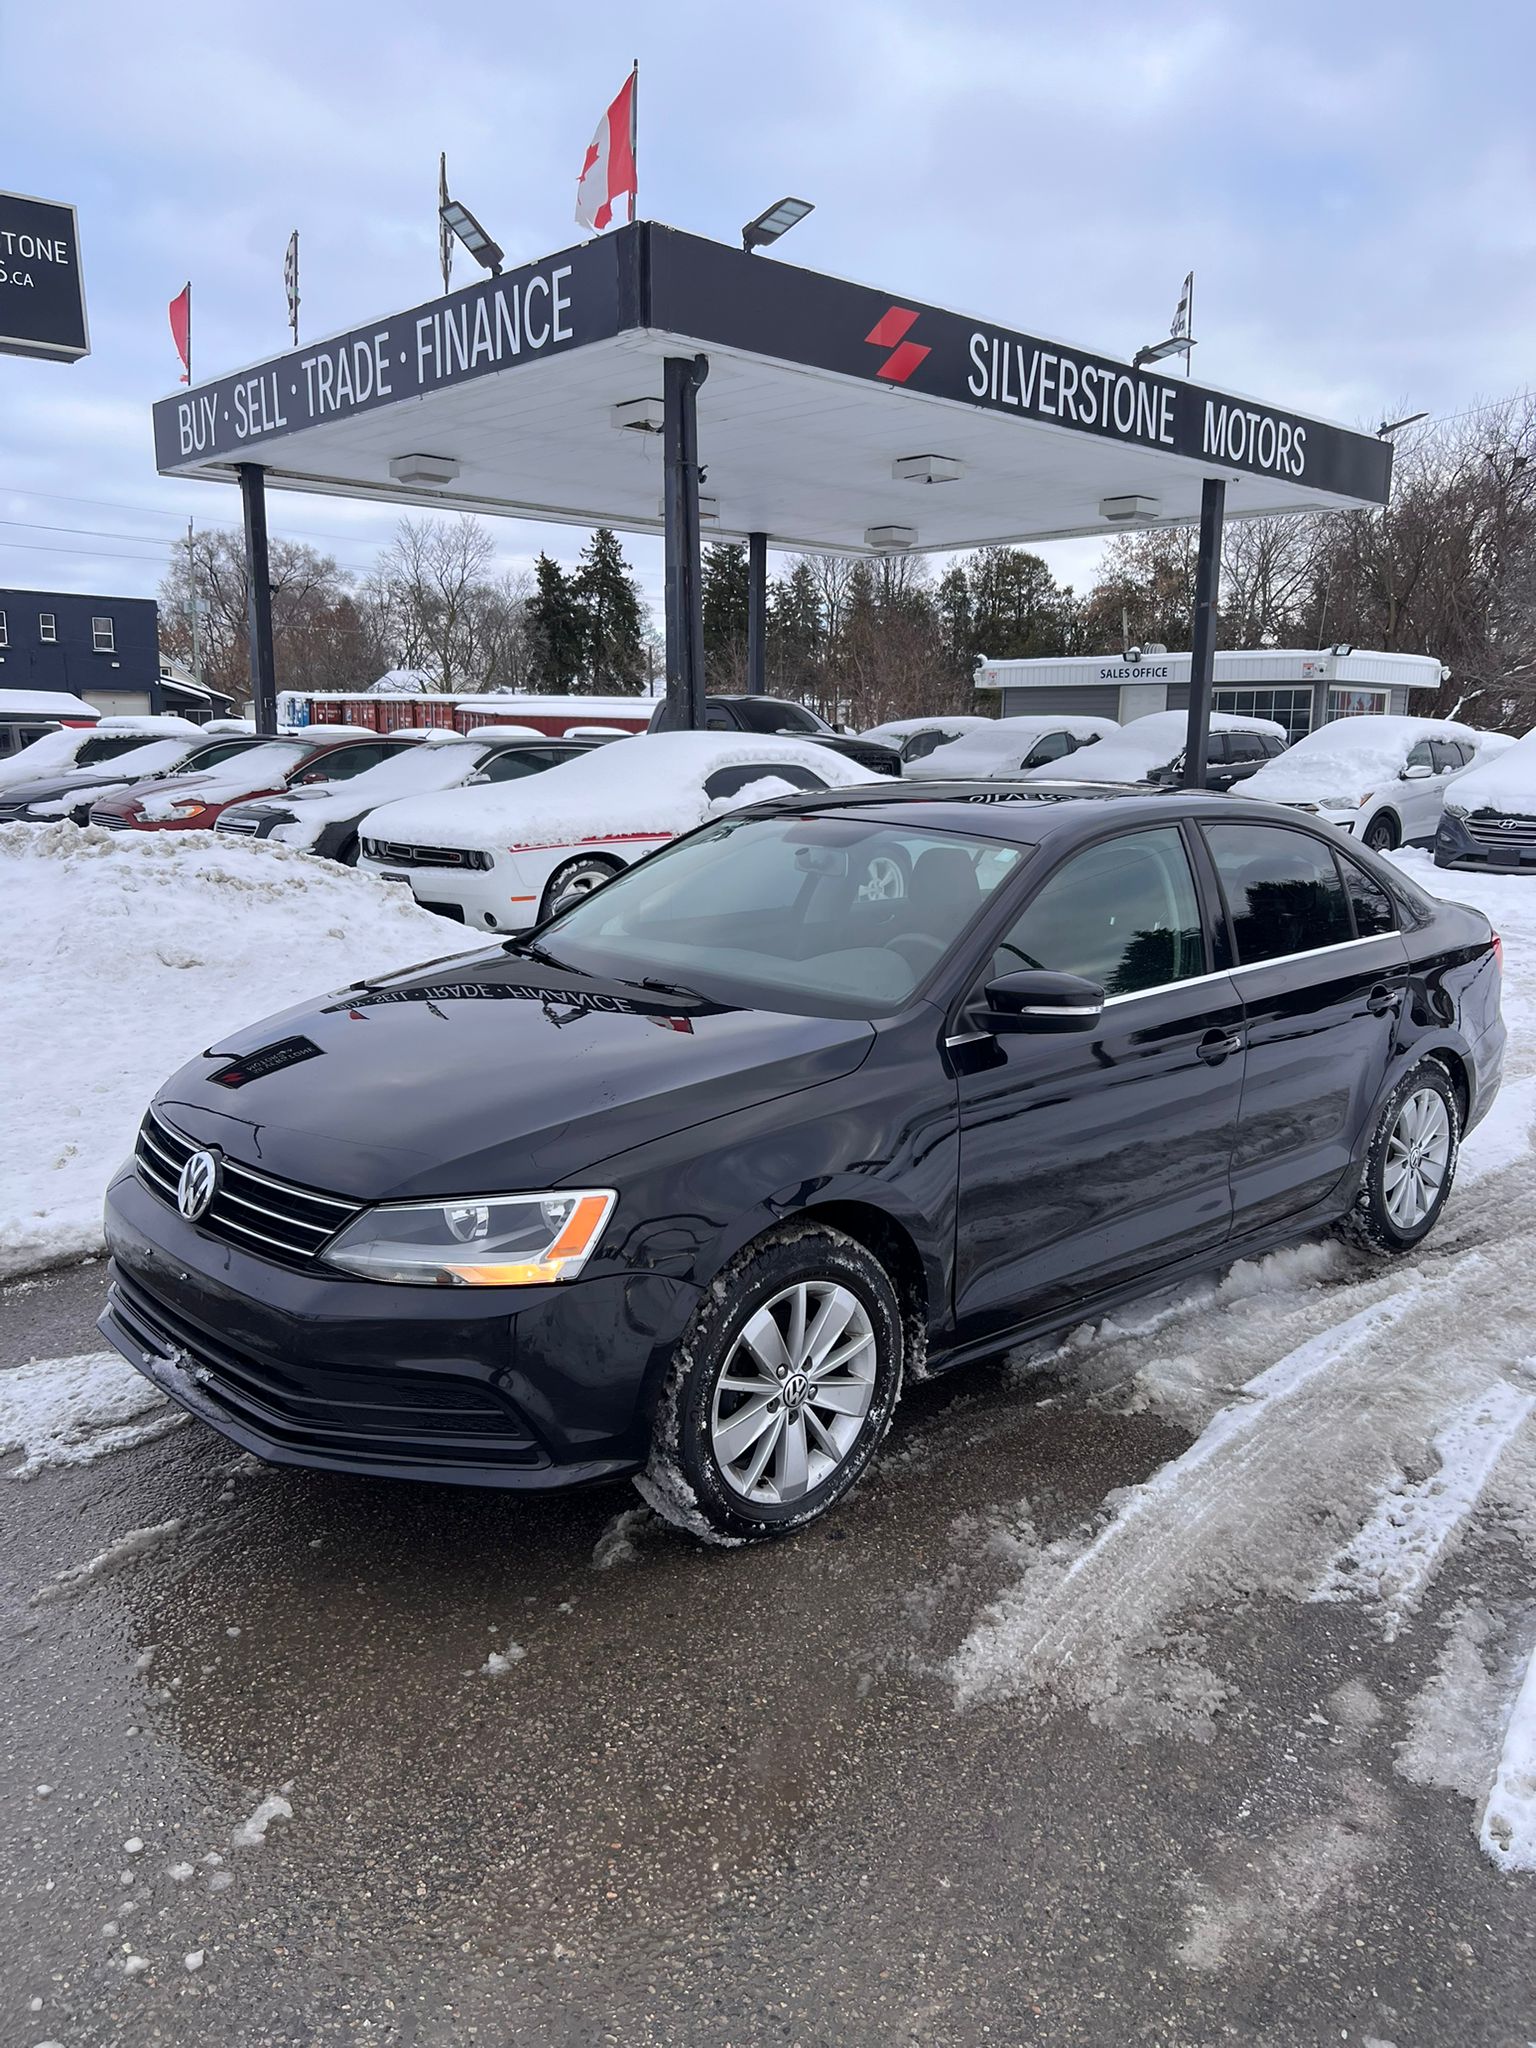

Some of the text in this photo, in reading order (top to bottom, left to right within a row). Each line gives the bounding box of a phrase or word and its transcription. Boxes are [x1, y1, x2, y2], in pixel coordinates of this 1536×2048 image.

[178, 265, 573, 455] BUY SELL TRADE FINANCE
[967, 332, 1307, 476] SILVERSTONE MOTORS
[1100, 667, 1167, 679] SALES OFFICE
